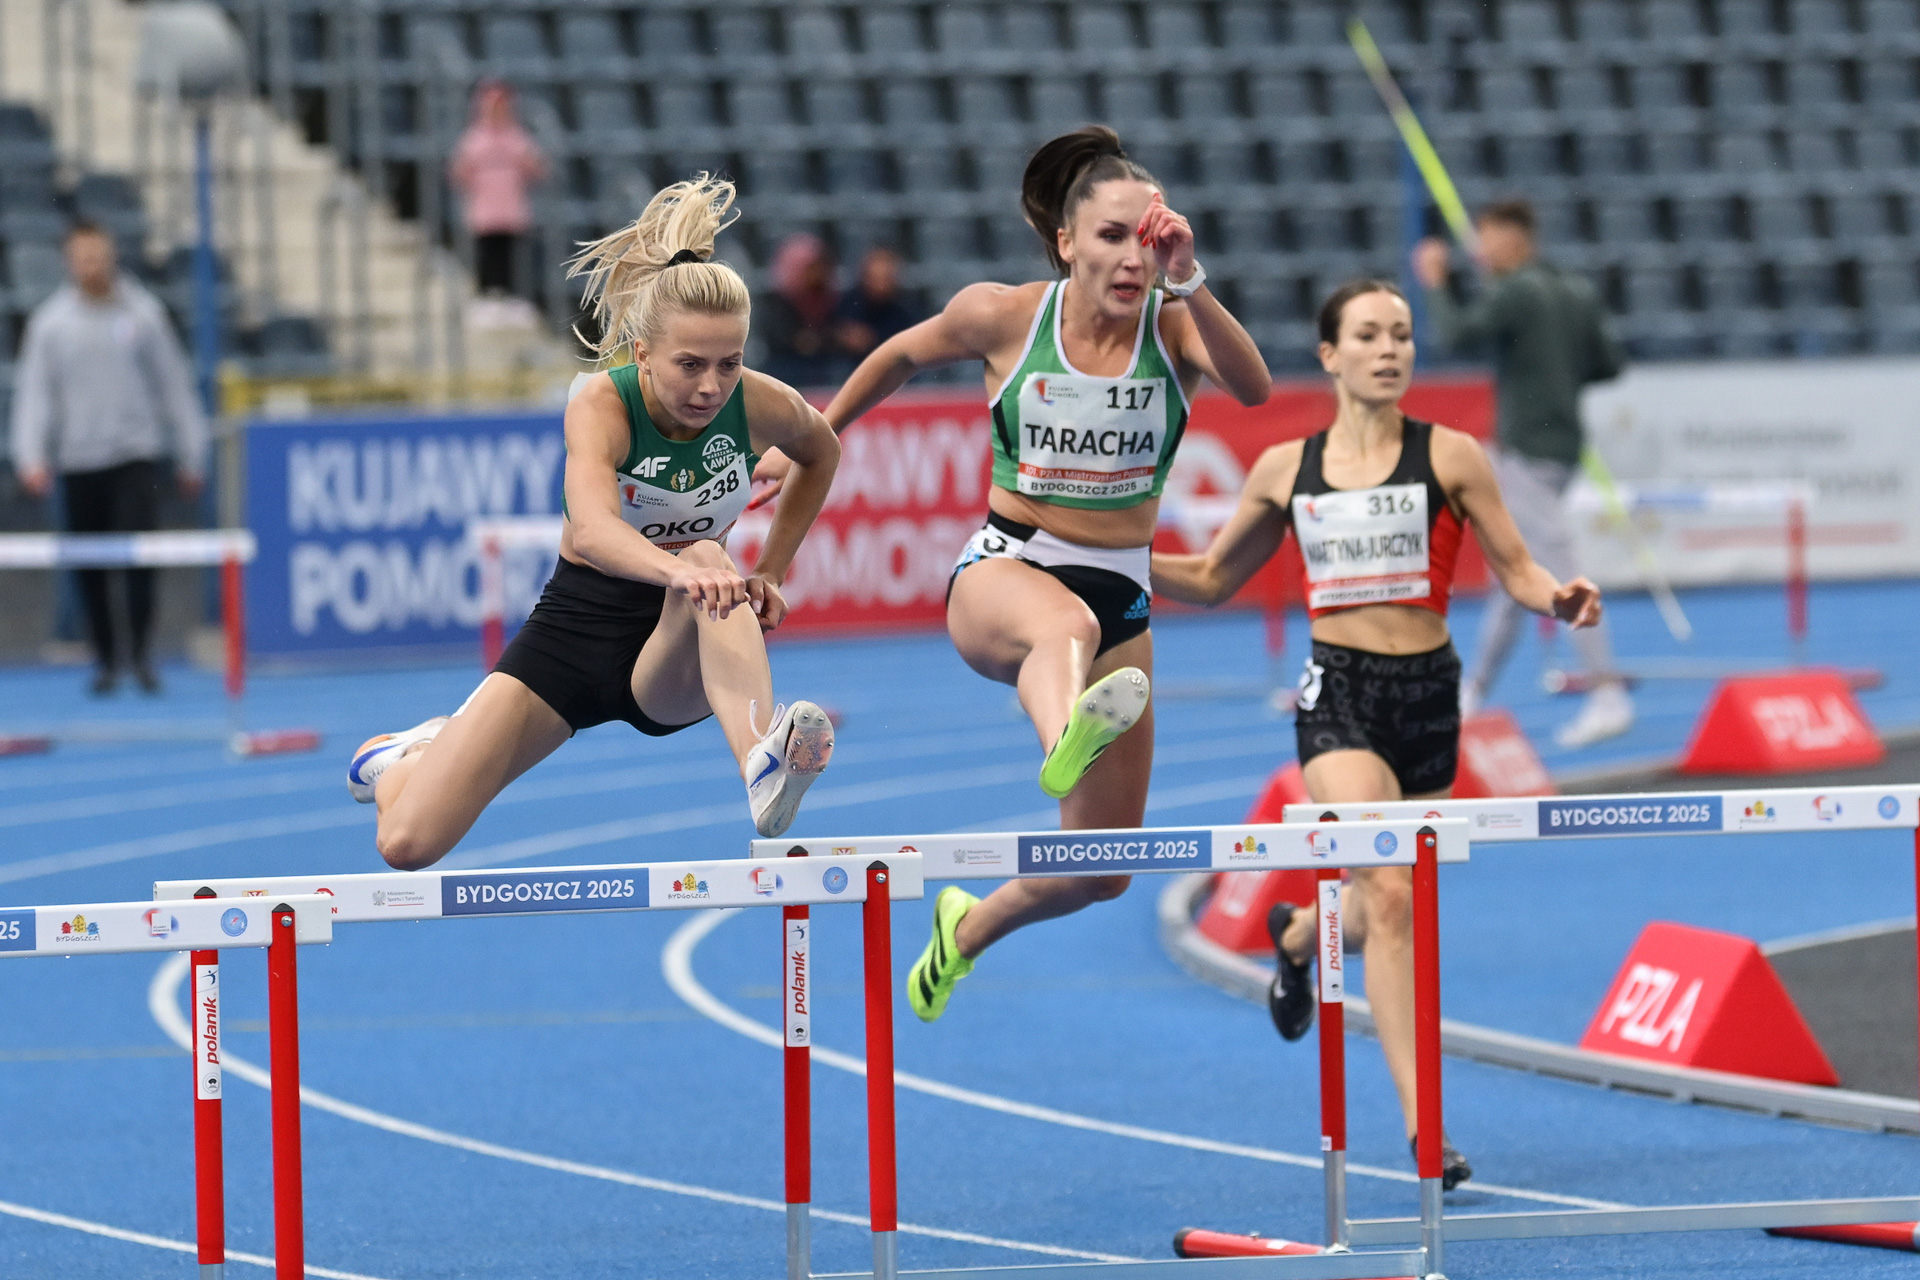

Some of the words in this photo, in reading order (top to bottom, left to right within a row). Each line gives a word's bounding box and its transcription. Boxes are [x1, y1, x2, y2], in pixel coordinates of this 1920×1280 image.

[1107, 386, 1154, 410] 117
[710, 440, 729, 453] AZS
[1025, 423, 1155, 457] TARACHA
[631, 456, 671, 478] 4F
[710, 454, 733, 470] AWF
[289, 436, 563, 533] KUJAWY
[678, 468, 688, 492] AWF
[1040, 468, 1063, 479] PZLA
[1065, 469, 1122, 482] Mistrzostwa
[1123, 468, 1149, 480] Polski
[637, 493, 664, 503] KUJAWY
[694, 469, 740, 508] 238
[1031, 481, 1108, 495] BYDGOSZCZ
[1111, 482, 1137, 494] 2025
[636, 498, 669, 507] POMORZE
[1368, 493, 1415, 517] 316
[1124, 607, 1149, 619] adida
[1551, 806, 1664, 827] BYDGOSZCZ
[1666, 804, 1711, 823] 2025
[1032, 843, 1149, 863] BYDGOSZCZ
[1153, 840, 1199, 859] 2025
[456, 881, 582, 904] BYDGOSZCZ
[586, 879, 635, 899] 2025
[668, 891, 710, 900] BYDGOSZCZ
[56, 932, 101, 942] BYDGOSZCZ
[1326, 910, 1342, 971] polanik
[791, 950, 808, 1015] polanik
[1600, 962, 1704, 1054] PZLA
[202, 996, 220, 1065] polanik
